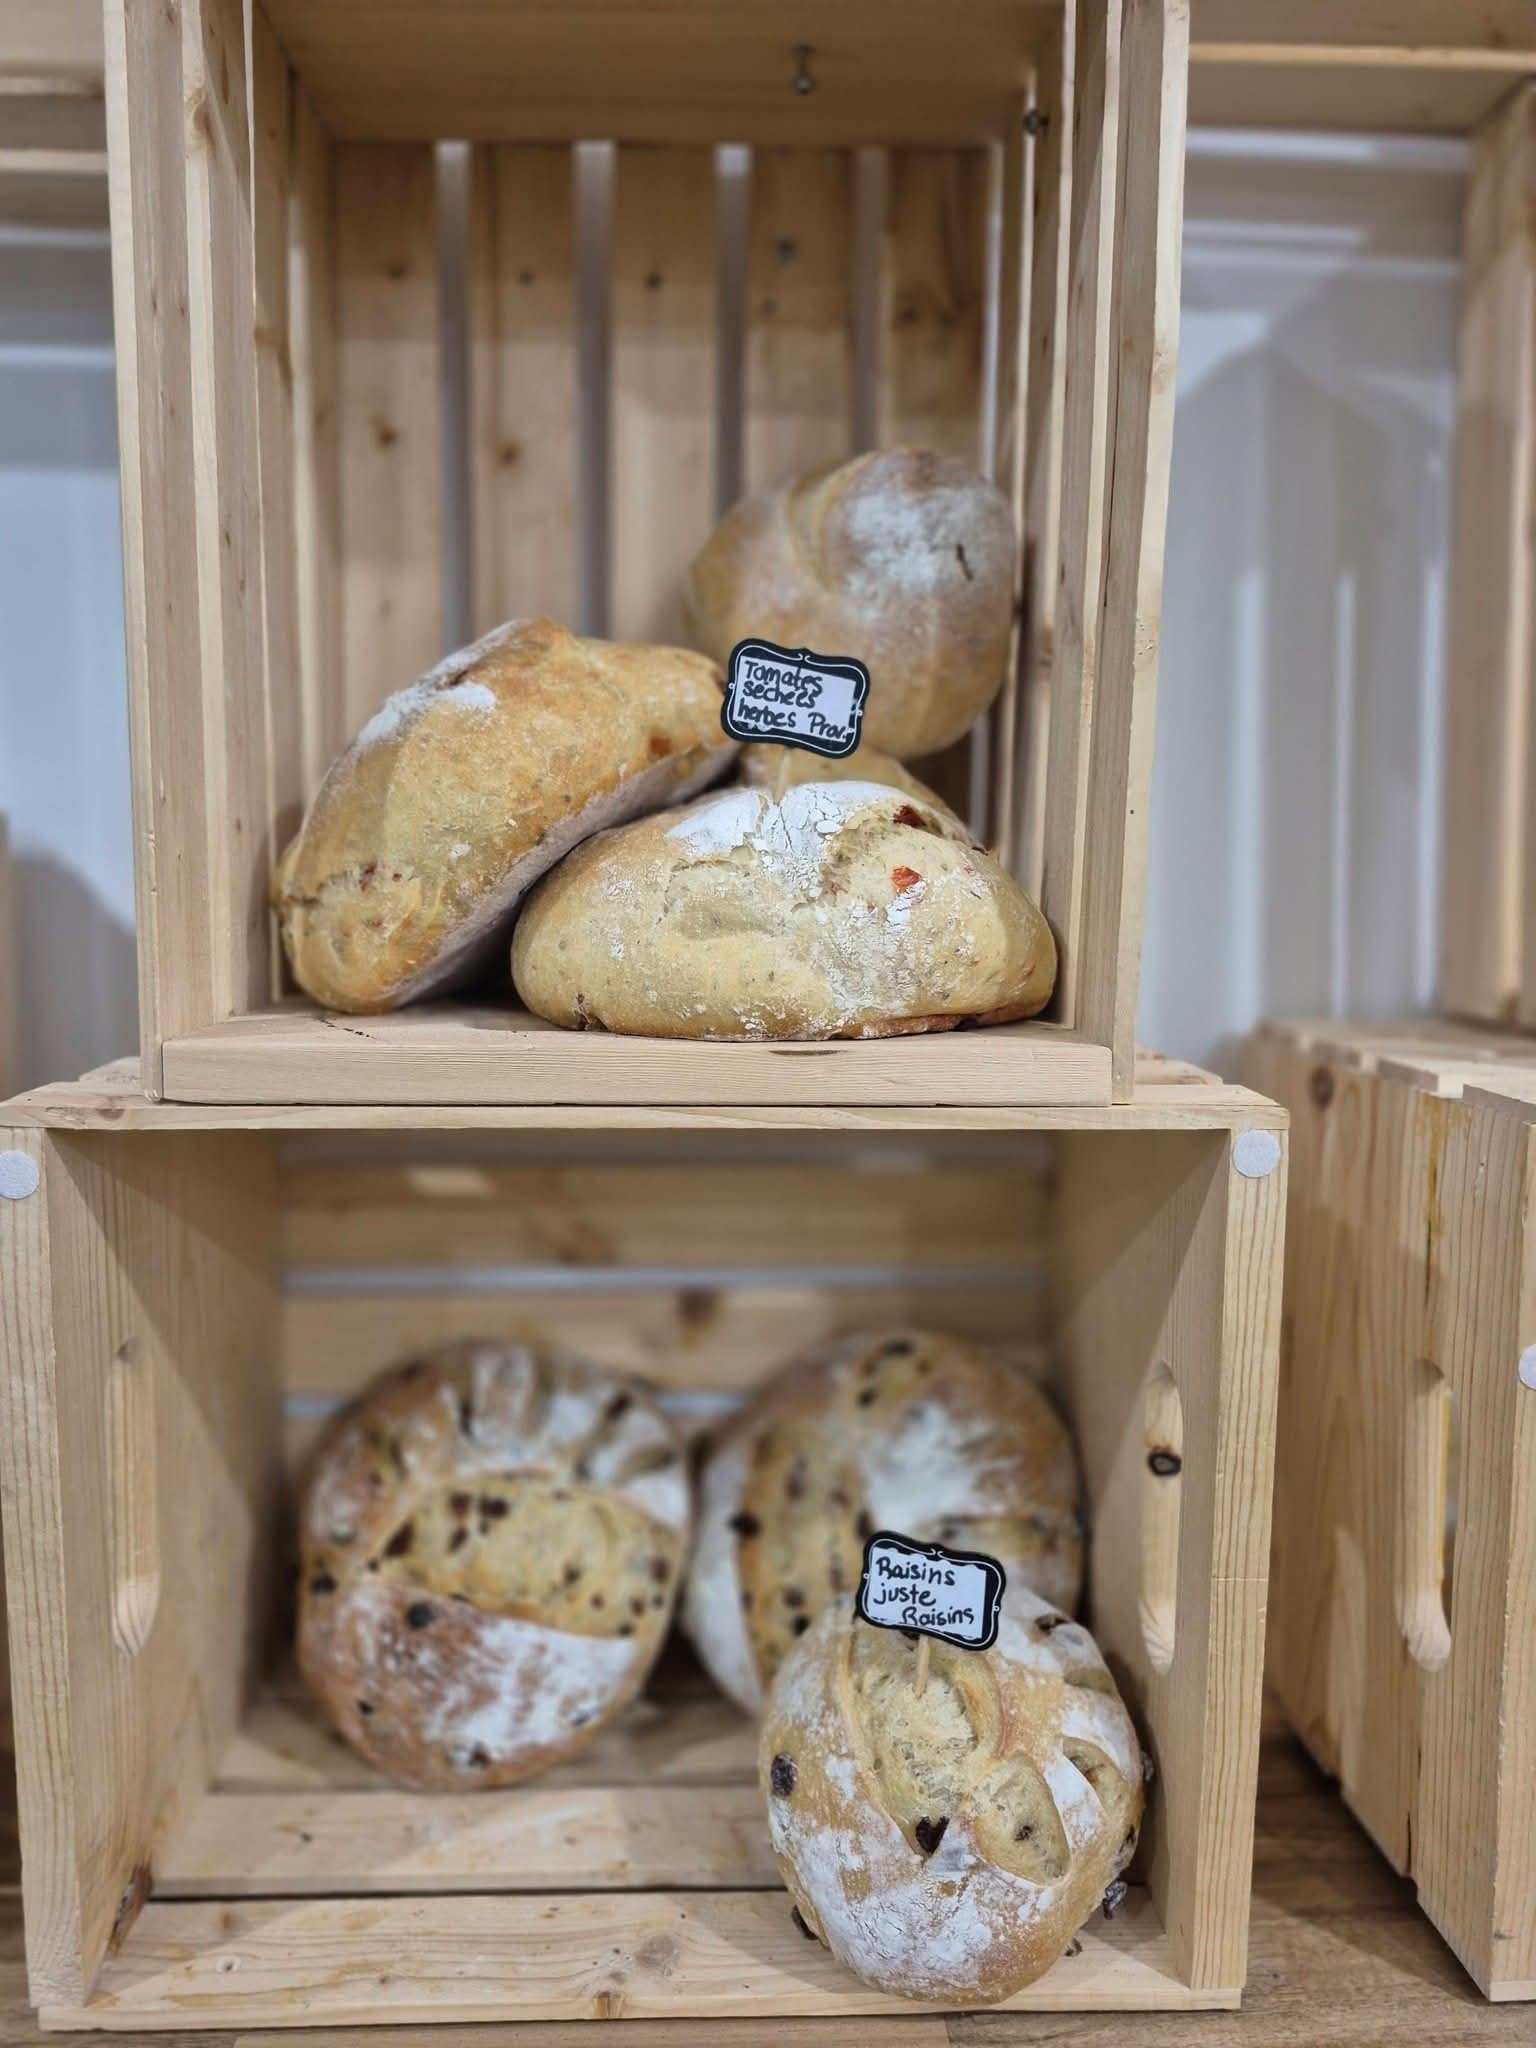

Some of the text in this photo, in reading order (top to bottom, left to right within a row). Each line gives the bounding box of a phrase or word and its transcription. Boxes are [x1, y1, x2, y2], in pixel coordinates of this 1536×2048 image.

[744, 660, 823, 697] Tomates
[737, 698, 797, 727] herbes
[876, 1556, 955, 1586] Raisins
[873, 1583, 937, 1607] juste
[900, 1606, 975, 1626] Raisins
